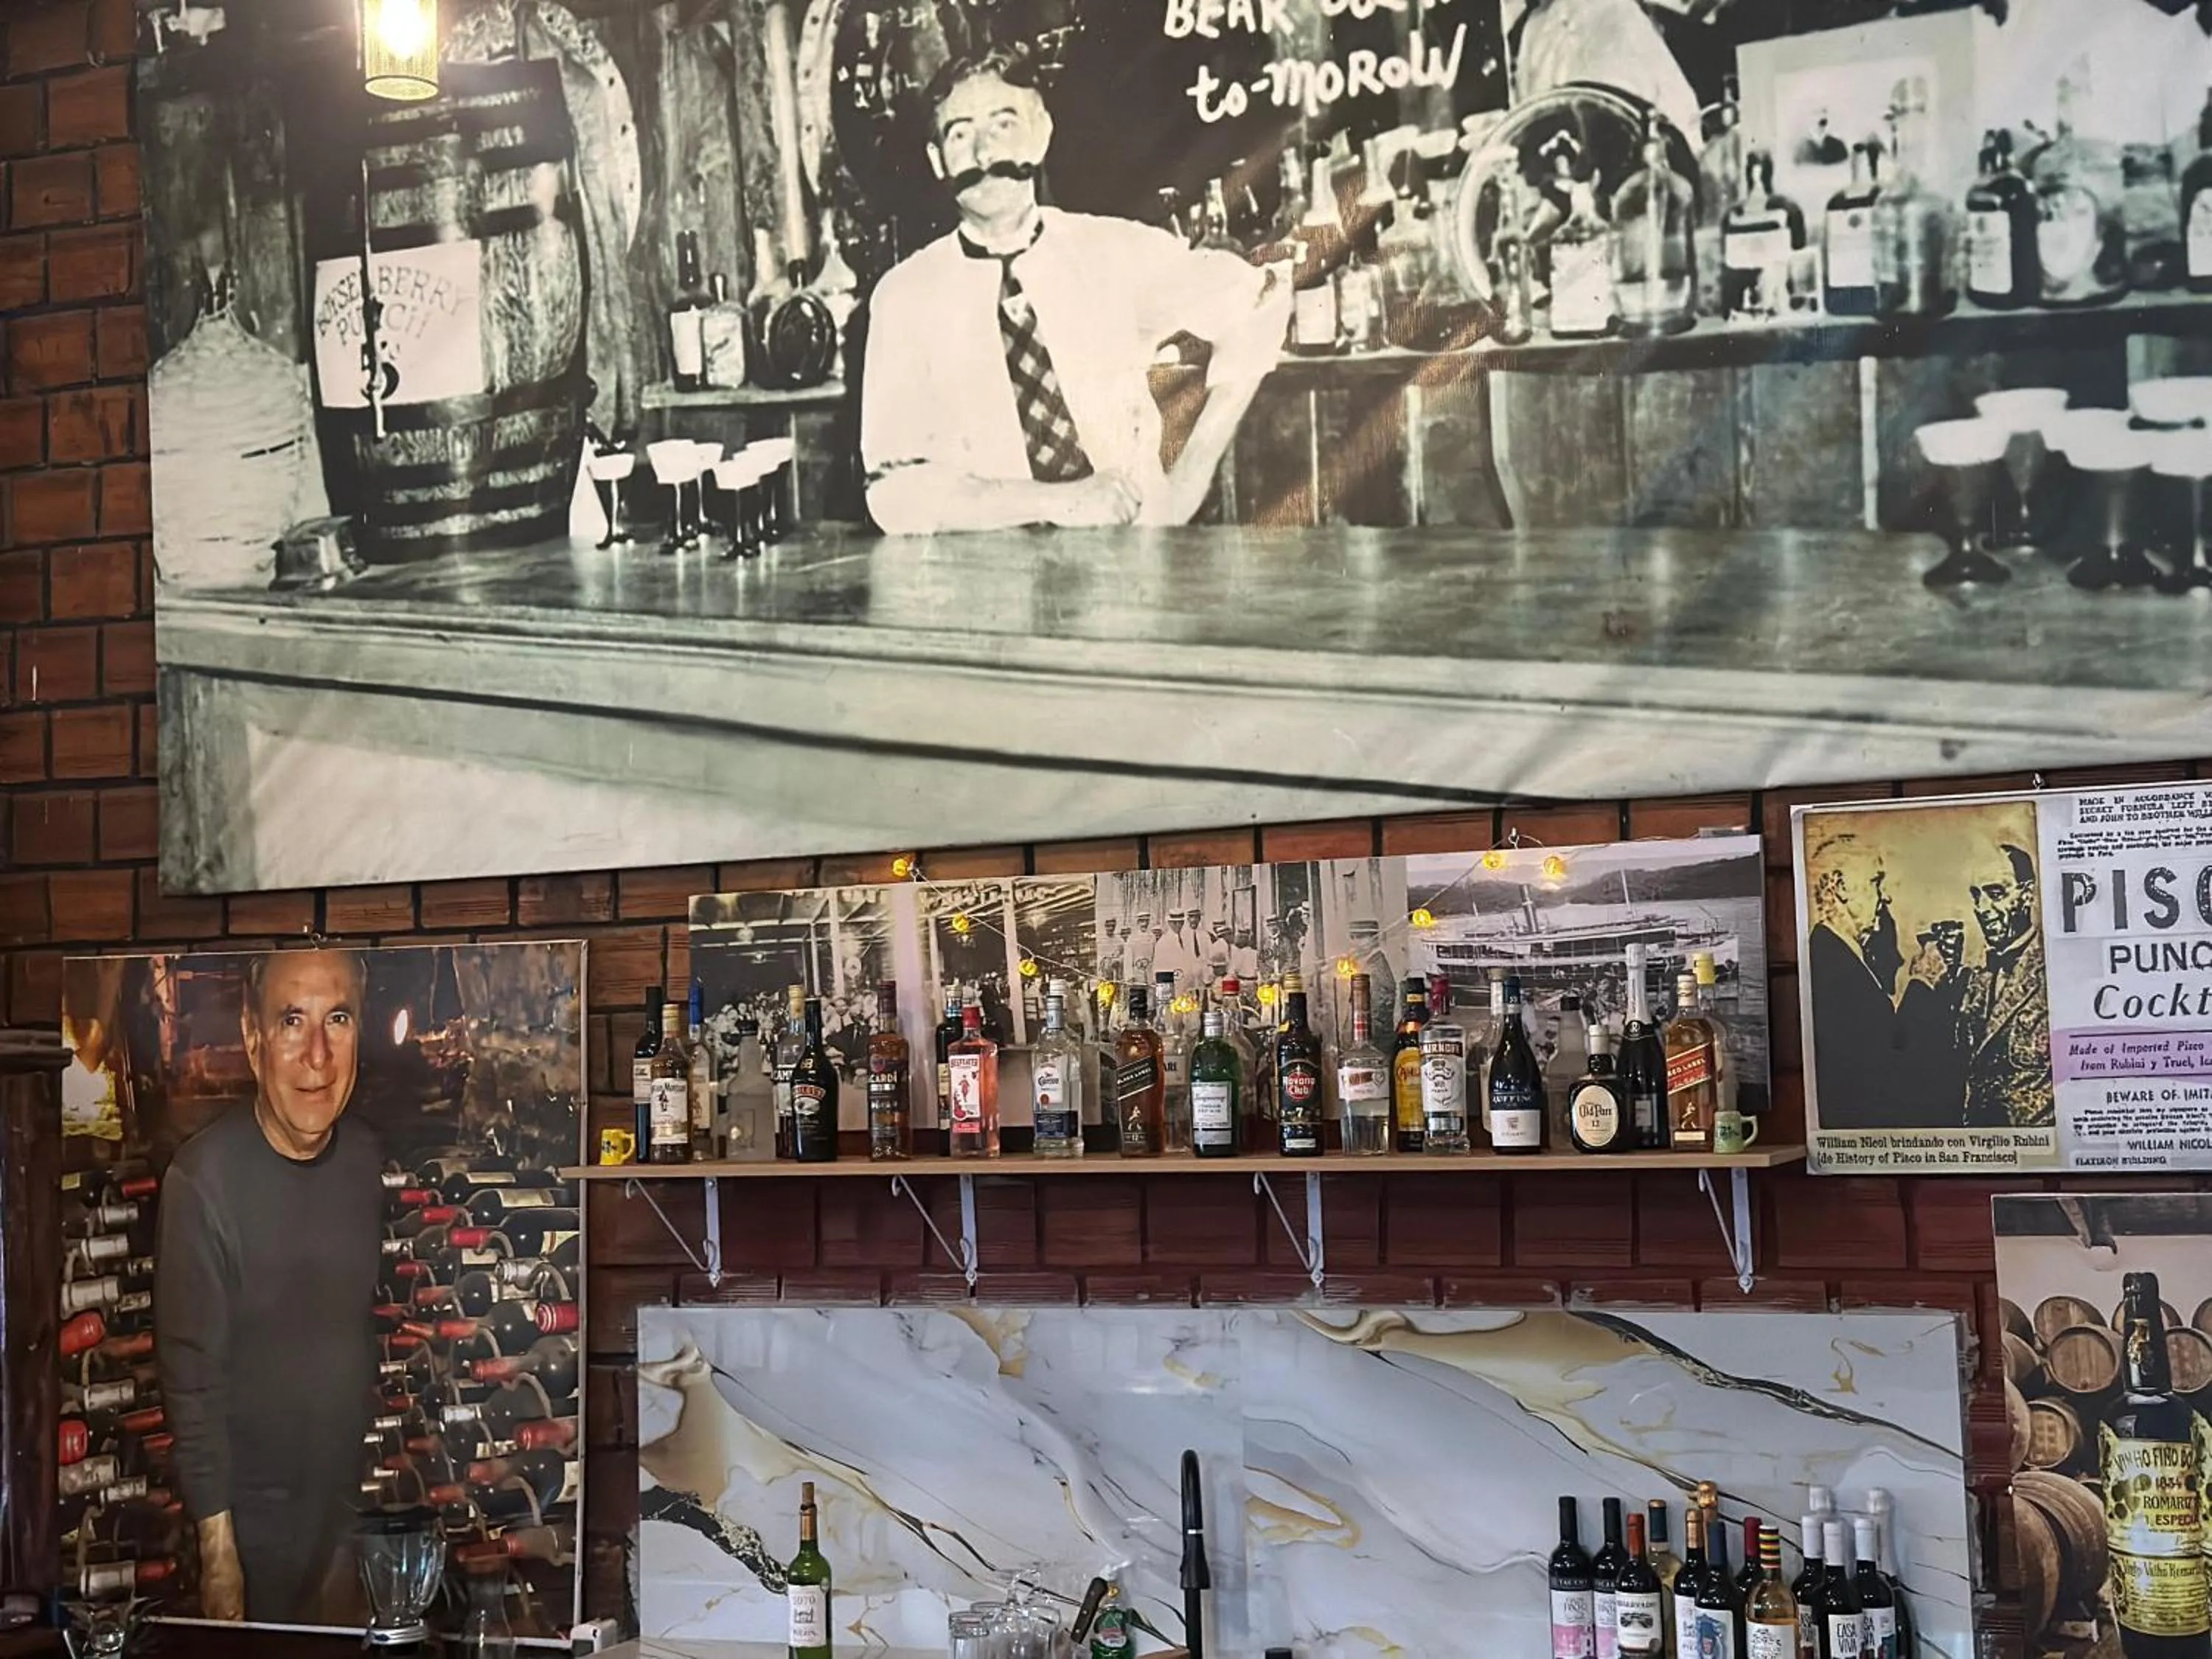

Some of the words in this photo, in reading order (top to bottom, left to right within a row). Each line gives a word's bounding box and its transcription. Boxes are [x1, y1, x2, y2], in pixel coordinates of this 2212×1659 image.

[2069, 1043, 2098, 1056] Made
[2104, 1043, 2115, 1054] of
[2122, 1040, 2170, 1054] Imported
[2177, 1040, 2204, 1051] Pisco
[2081, 1060, 2106, 1071] from
[2111, 1058, 2145, 1069] Rubini
[2107, 1090, 2154, 1104] BEWARE
[1816, 1136, 1857, 1149] William
[1890, 1135, 1944, 1149] brindando
[1947, 1138, 1966, 1148] con
[1969, 1135, 2010, 1150] Virgilio
[2014, 1135, 2051, 1148] Rubini
[2127, 1139, 2174, 1151] WILLIAM
[1836, 1152, 1875, 1166] History
[1879, 1152, 1890, 1164] of
[1893, 1152, 1923, 1164] Pisco
[1926, 1151, 1936, 1164] in
[1939, 1152, 1959, 1163] San
